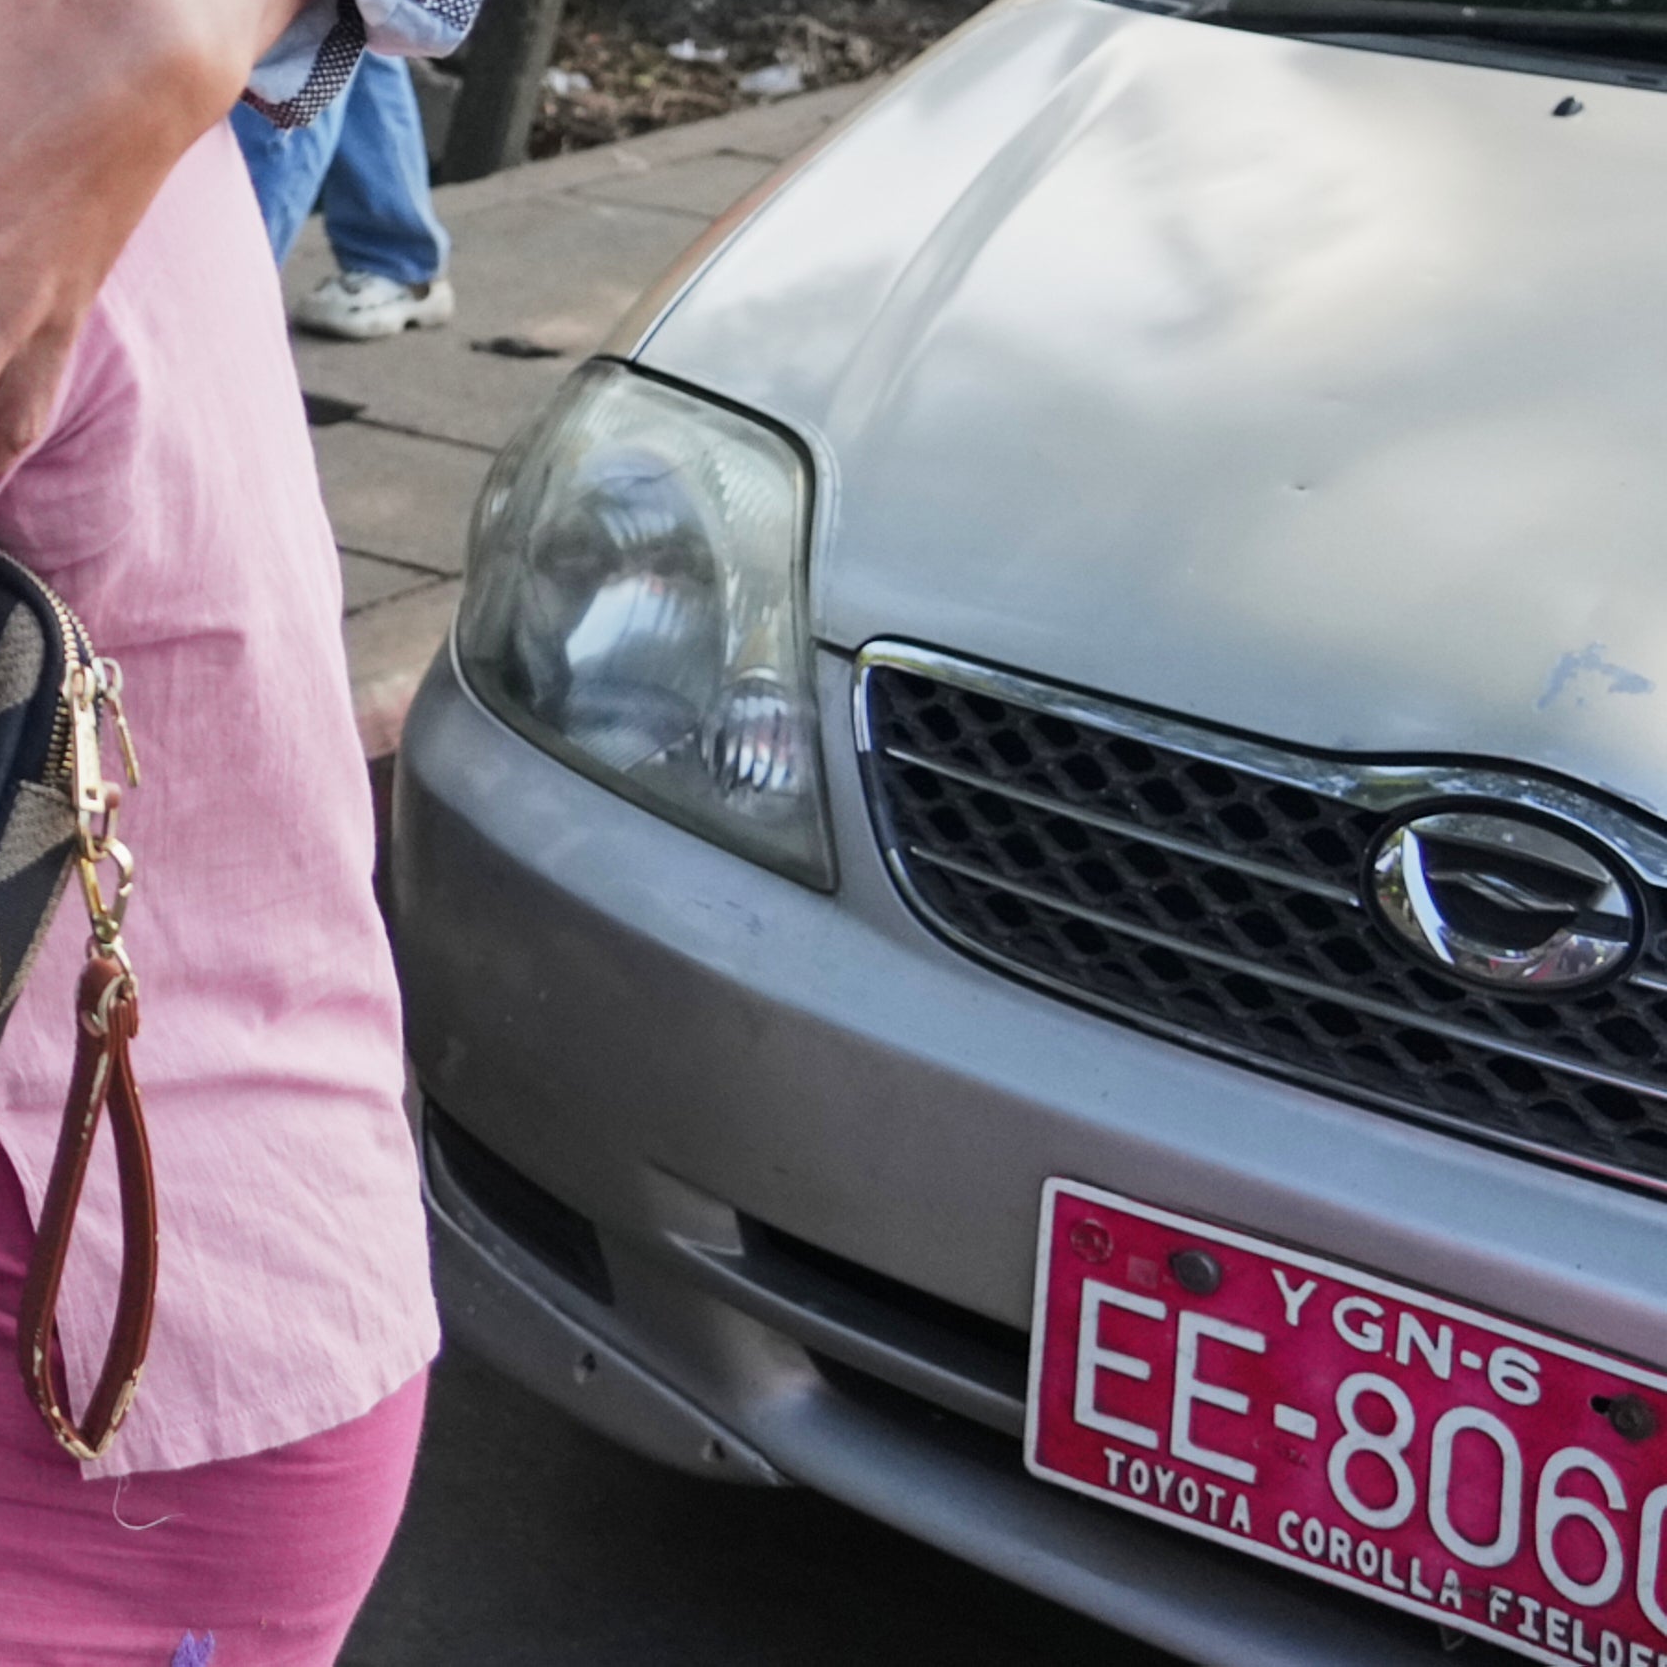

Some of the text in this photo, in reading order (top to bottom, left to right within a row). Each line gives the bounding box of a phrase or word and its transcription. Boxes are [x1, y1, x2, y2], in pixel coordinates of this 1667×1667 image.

[1271, 1267, 1541, 1406] YGN-6
[1103, 1447, 1667, 1667] TOYOTA COROLLA FIELDE
